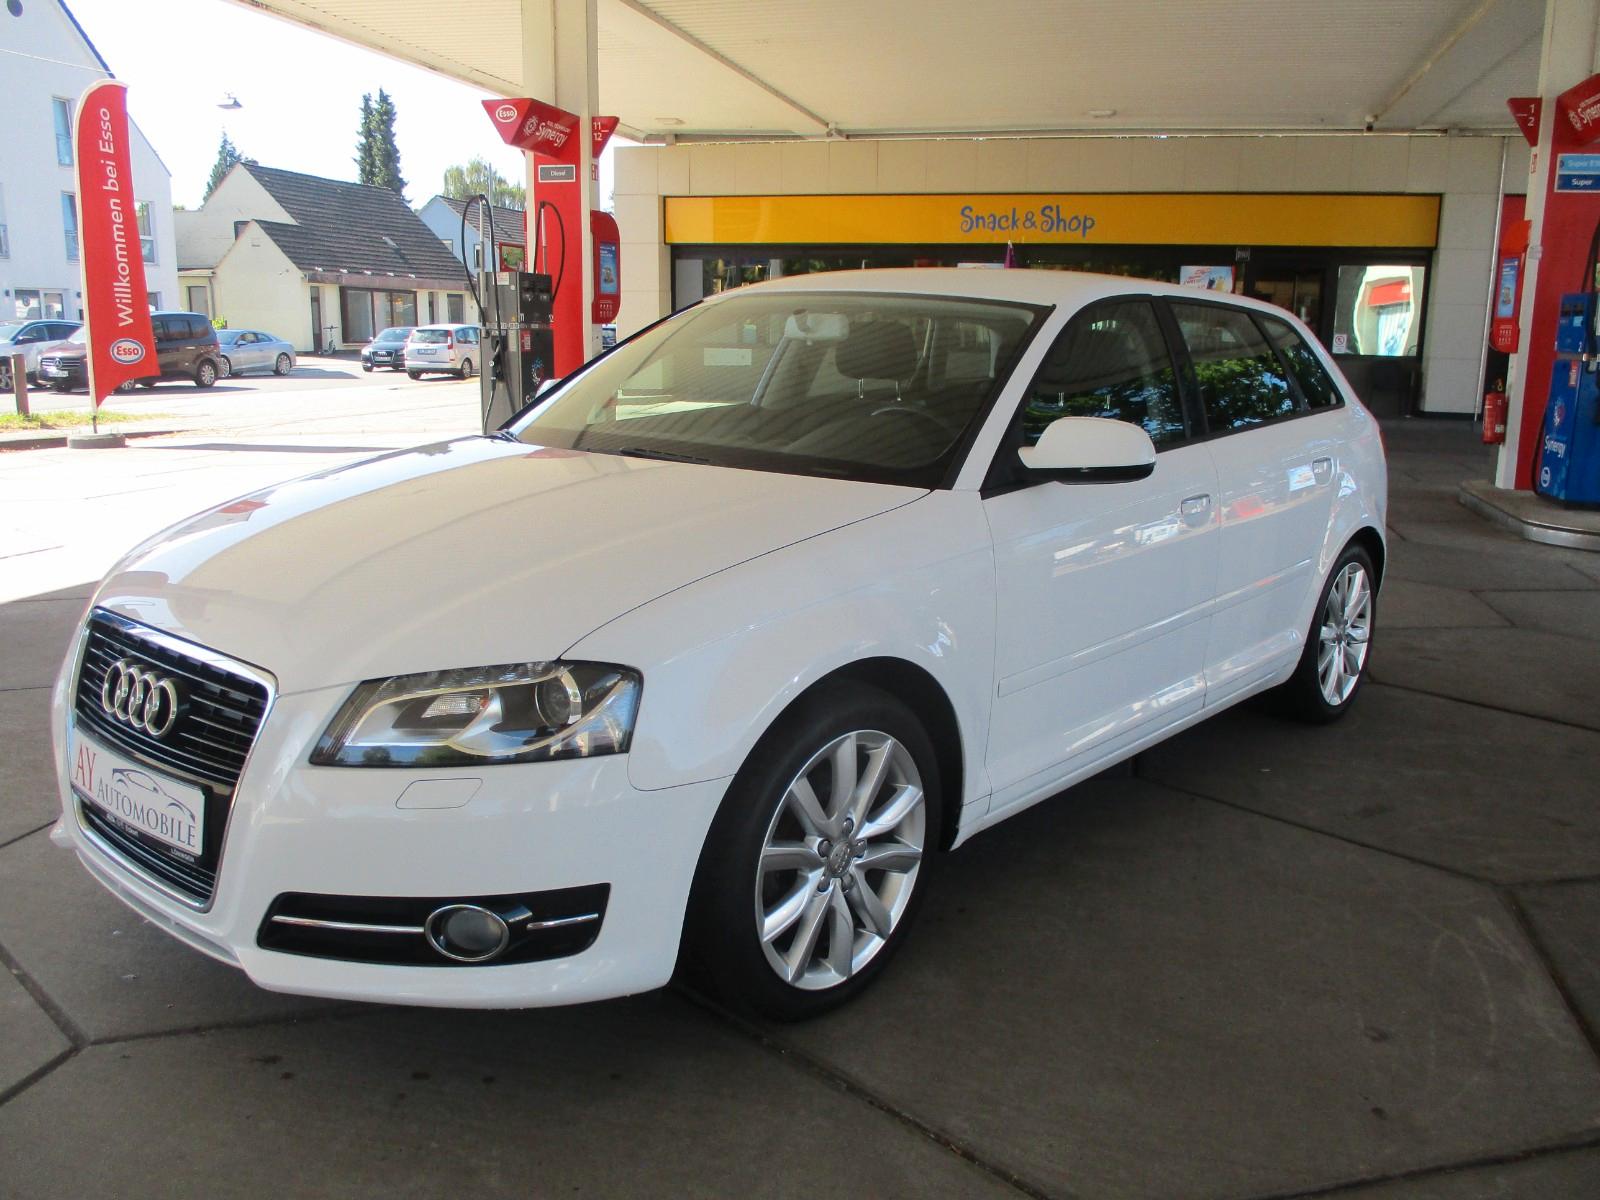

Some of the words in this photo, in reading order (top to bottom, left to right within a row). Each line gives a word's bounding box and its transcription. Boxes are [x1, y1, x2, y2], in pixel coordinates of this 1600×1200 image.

[99, 107, 114, 154] Esso
[536, 122, 568, 147] Synergy
[1527, 116, 1535, 126] 2
[101, 160, 119, 192] bei
[1571, 178, 1592, 187] Super
[110, 199, 134, 327] Willkommen
[116, 345, 140, 356] Esso
[75, 743, 97, 793] AY
[97, 776, 197, 848] AUTOMOBILE
